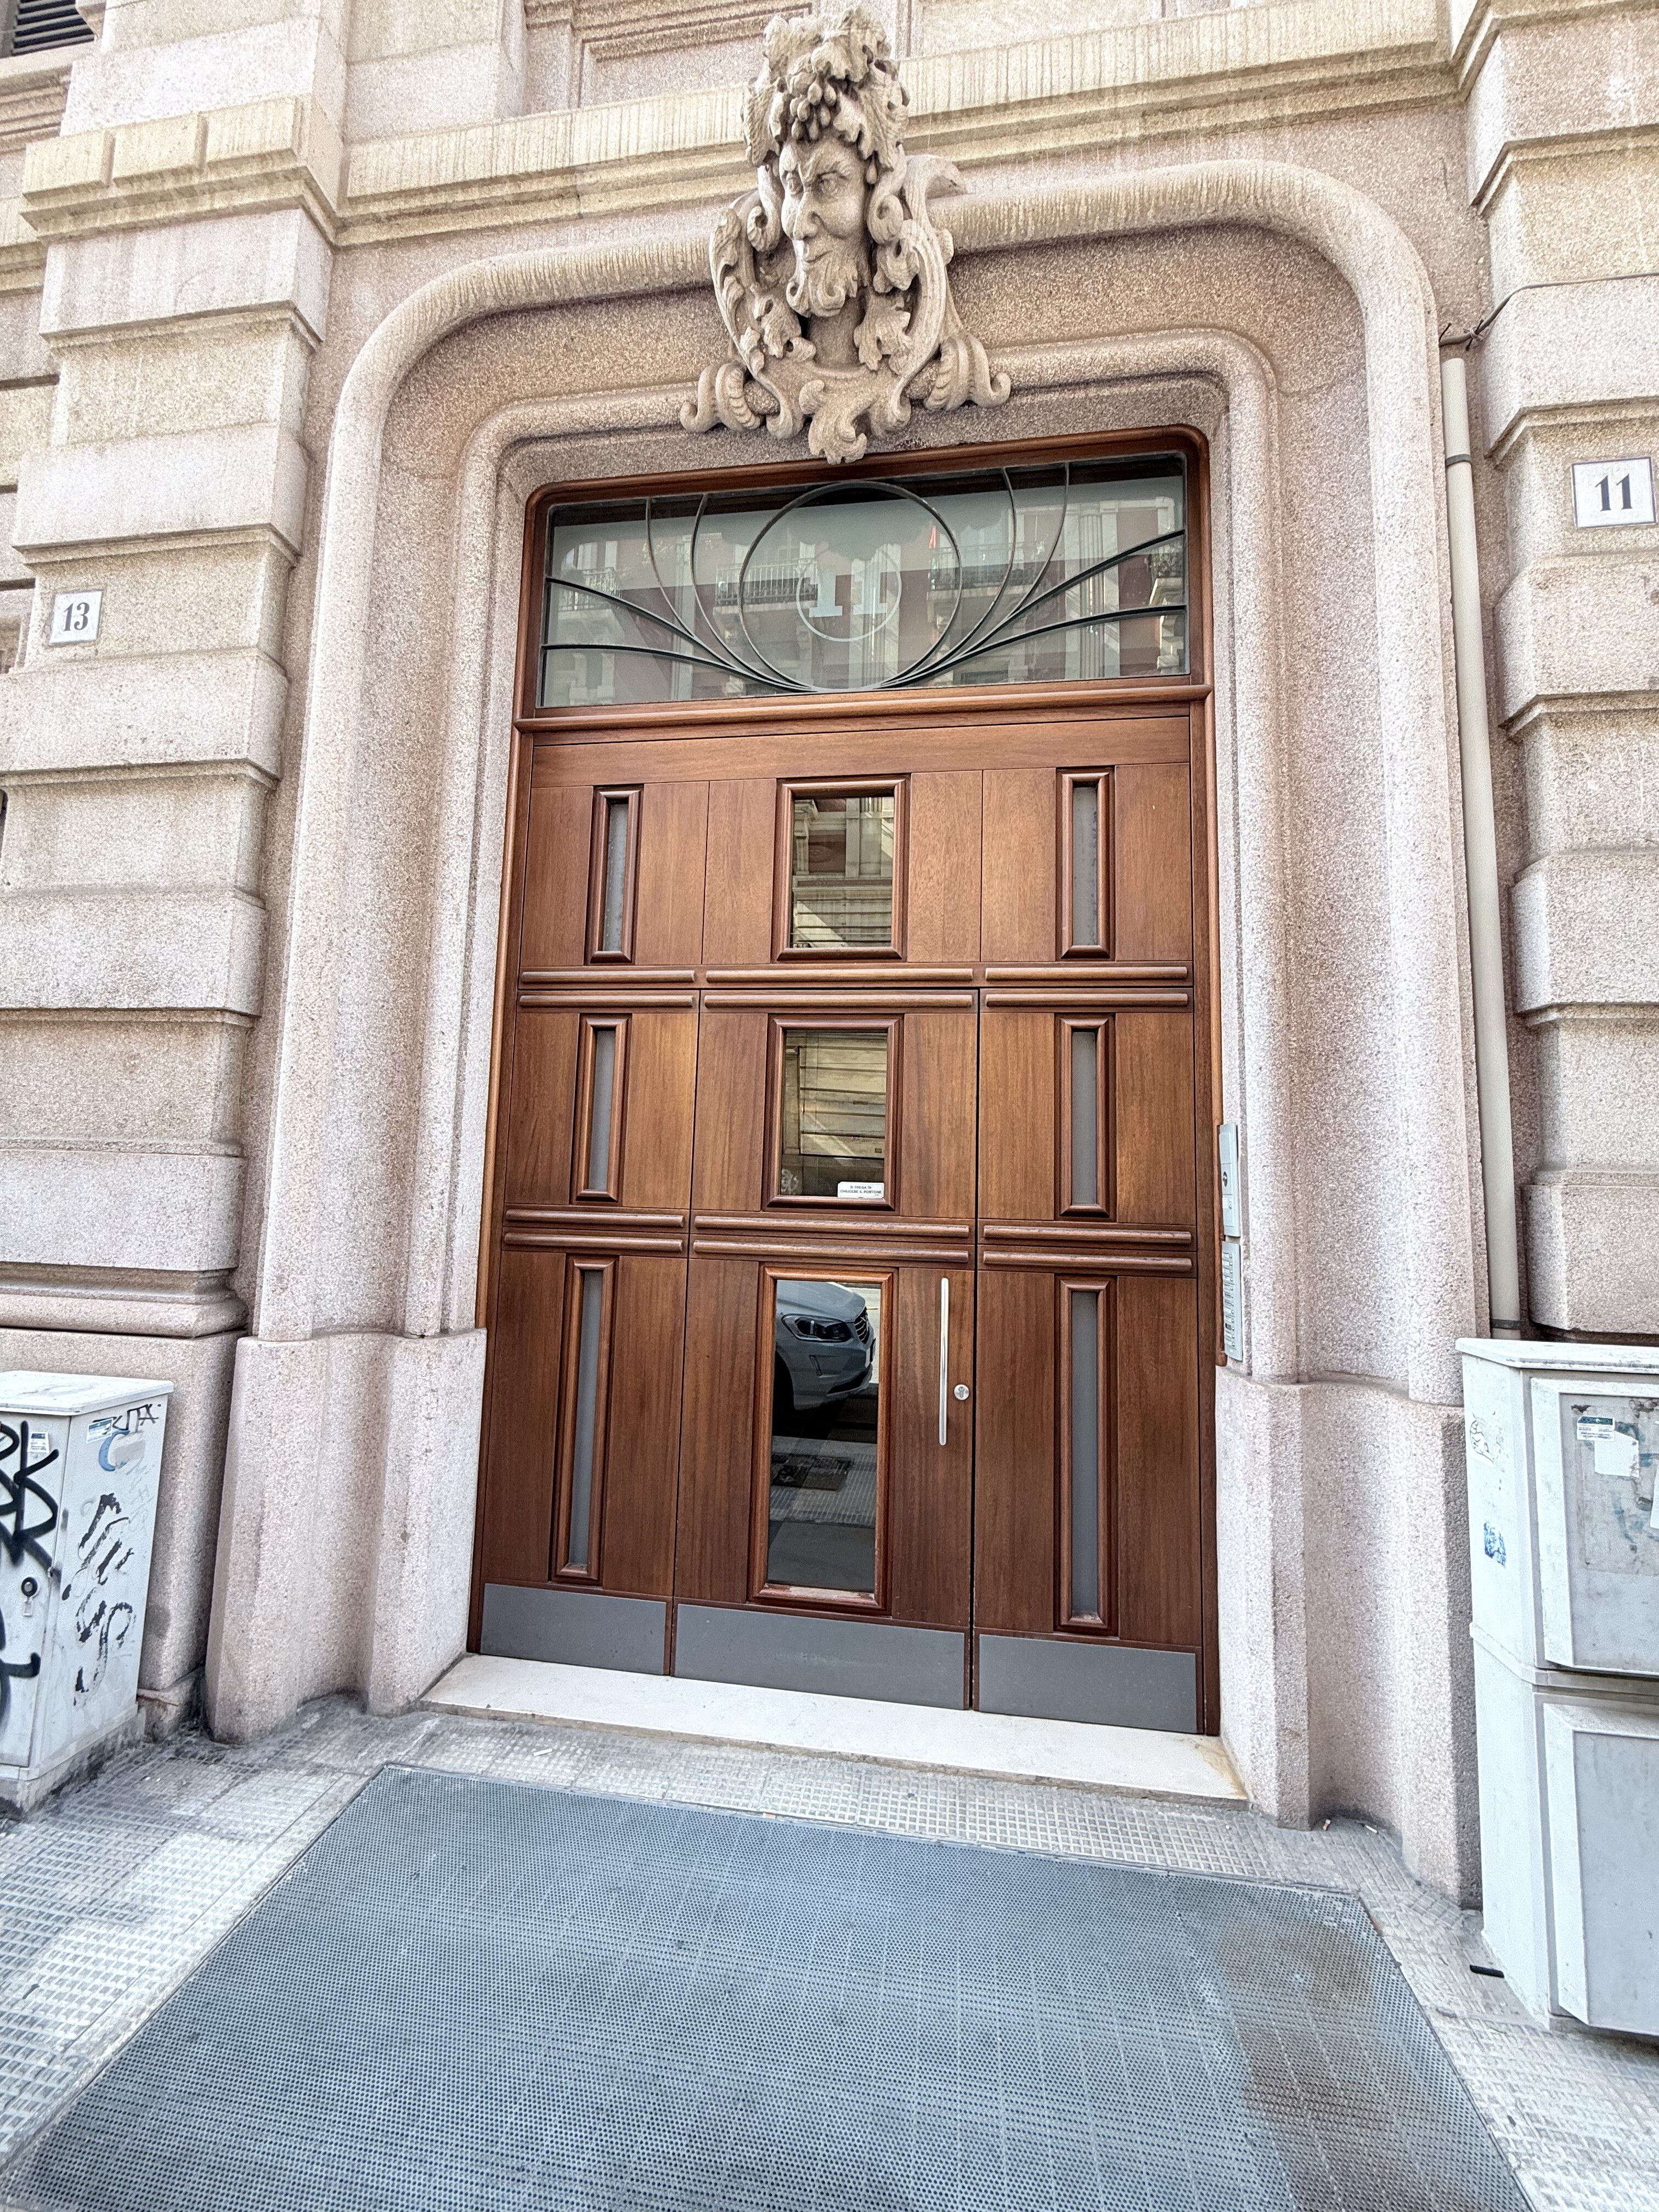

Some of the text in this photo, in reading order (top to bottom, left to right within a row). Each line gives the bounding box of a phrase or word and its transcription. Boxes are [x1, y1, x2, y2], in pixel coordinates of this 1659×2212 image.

[1594, 473, 1633, 512] 11
[809, 566, 888, 618] 11
[63, 602, 90, 631] 13
